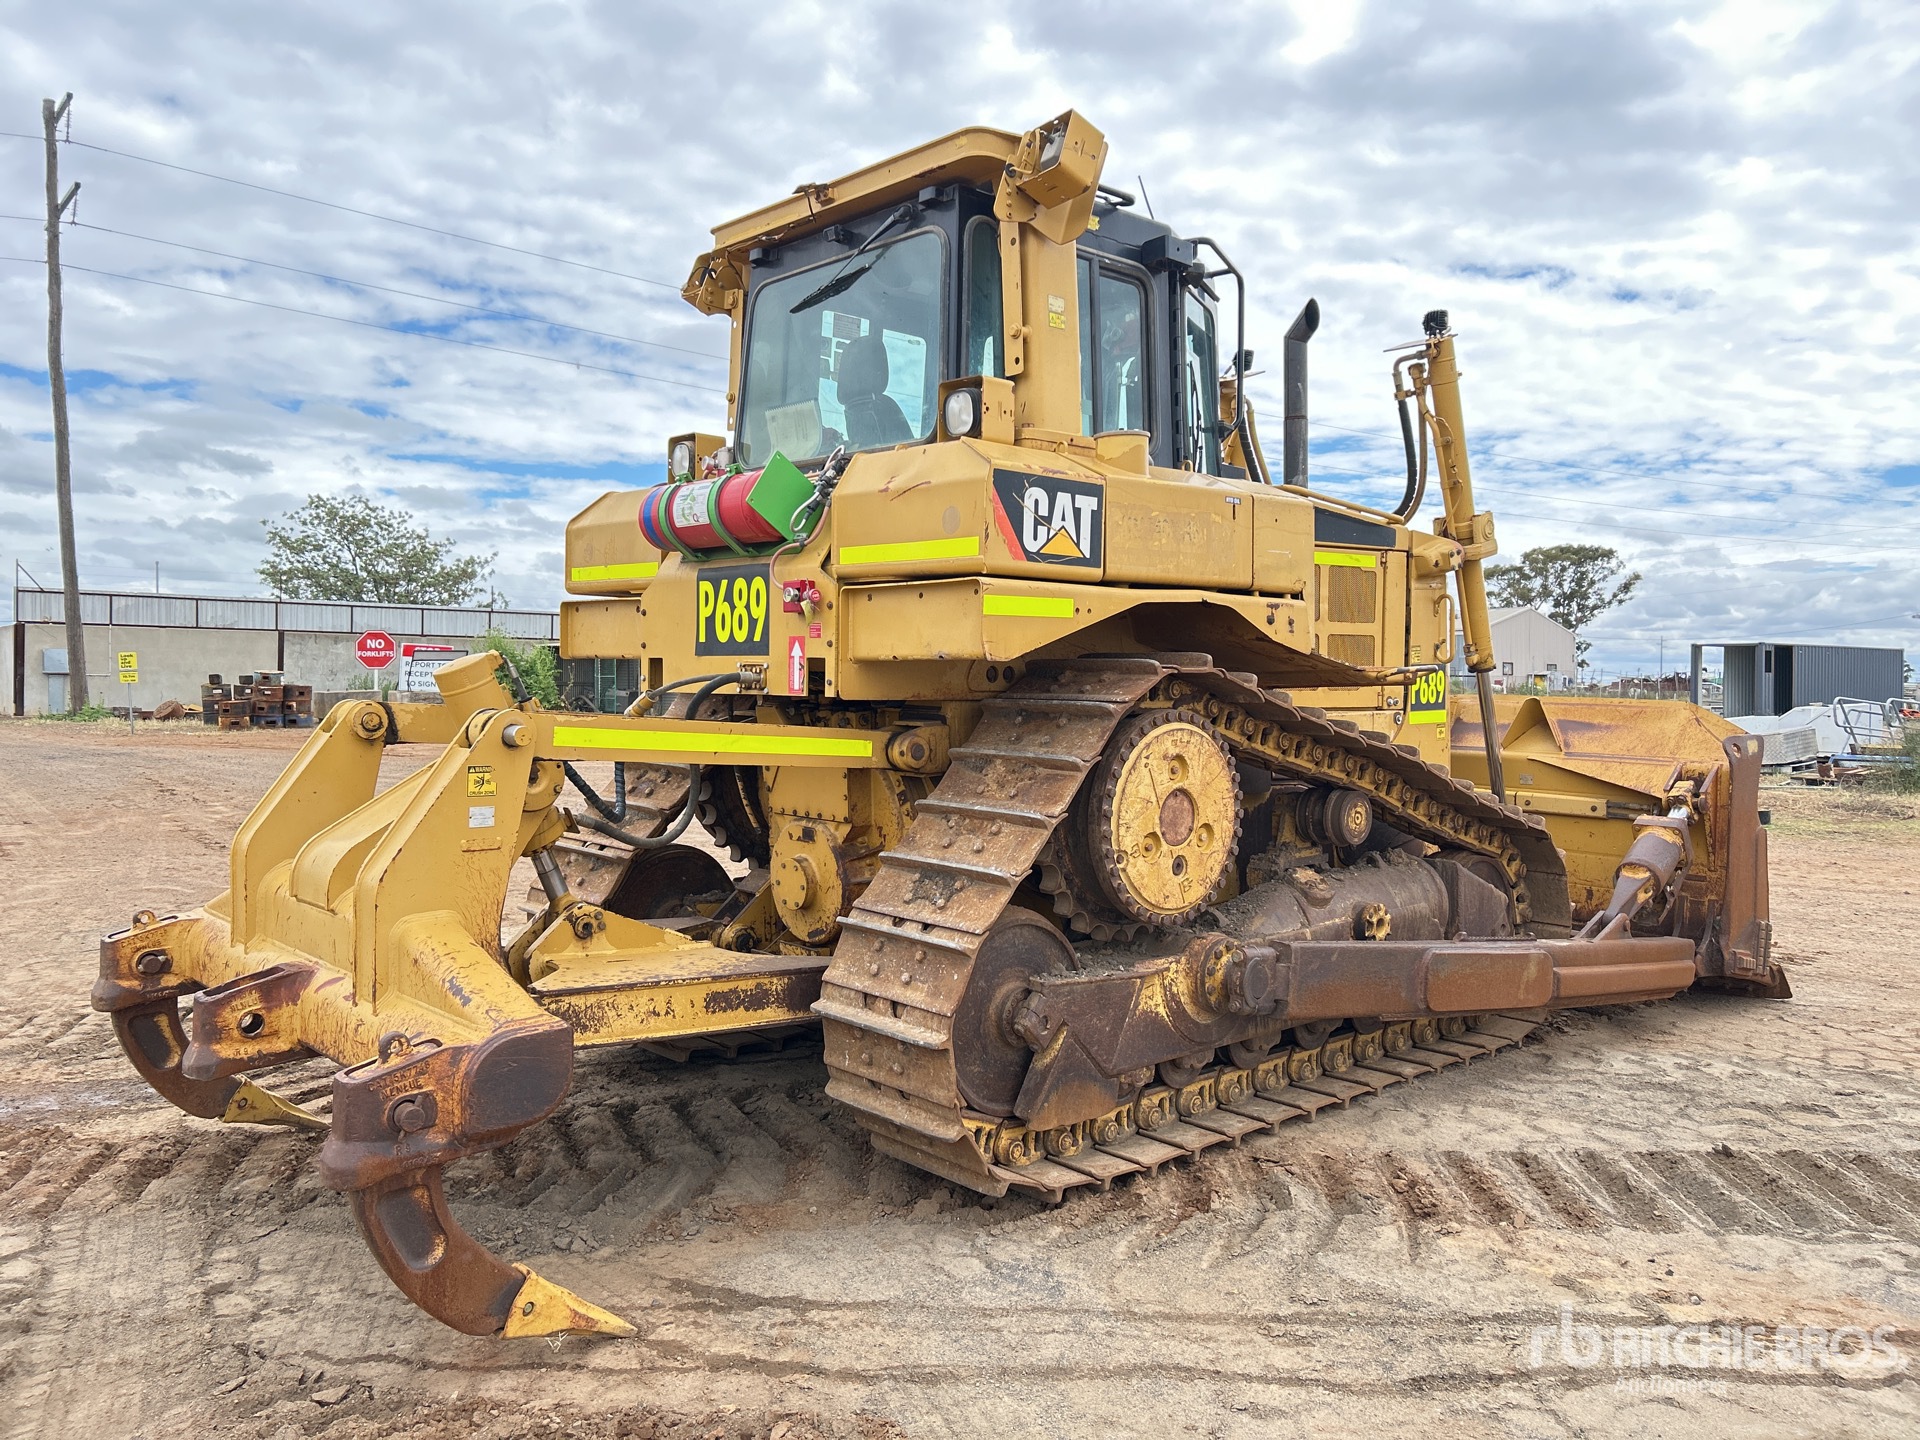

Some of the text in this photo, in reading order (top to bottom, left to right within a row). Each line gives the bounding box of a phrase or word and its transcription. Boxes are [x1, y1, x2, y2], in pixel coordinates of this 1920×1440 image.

[1023, 487, 1098, 558] CAT
[699, 576, 767, 643] P689
[367, 639, 385, 649] NO
[1411, 670, 1445, 704] P689
